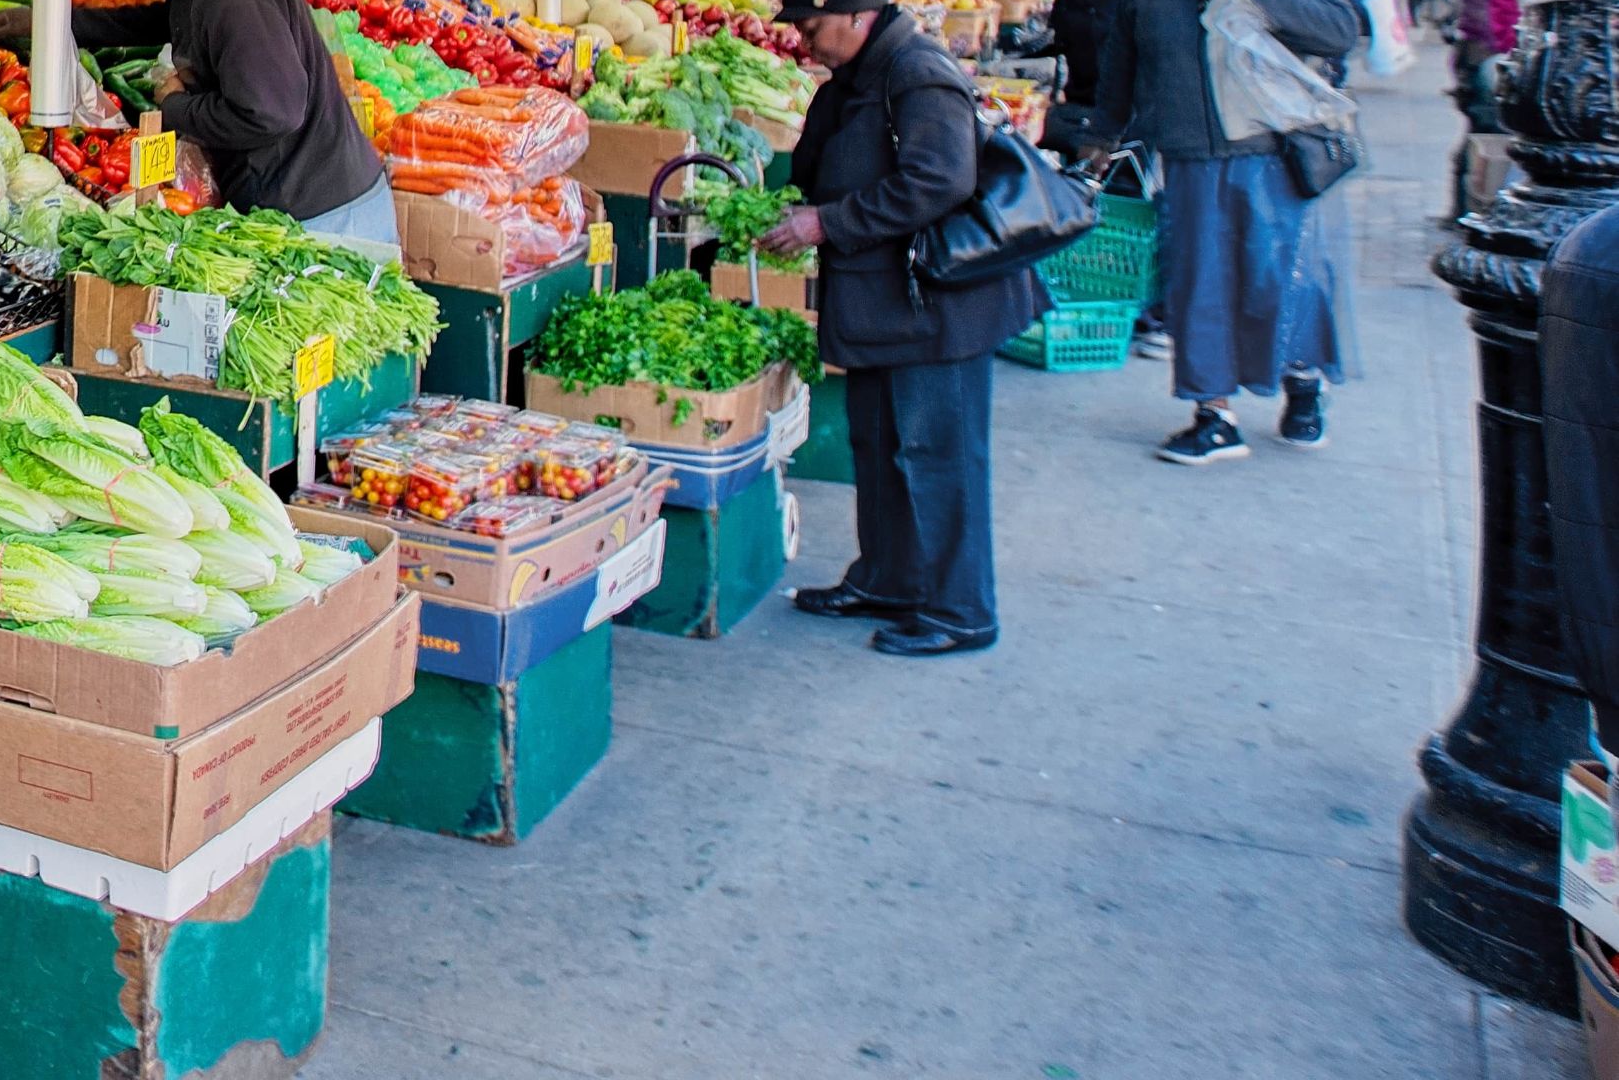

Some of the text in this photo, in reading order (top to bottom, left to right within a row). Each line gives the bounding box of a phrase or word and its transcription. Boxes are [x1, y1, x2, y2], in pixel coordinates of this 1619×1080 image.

[192, 734, 256, 781] PRODUCT OF CANADA
[259, 710, 351, 786] LIGHT SALTED DRIED CODFISH
